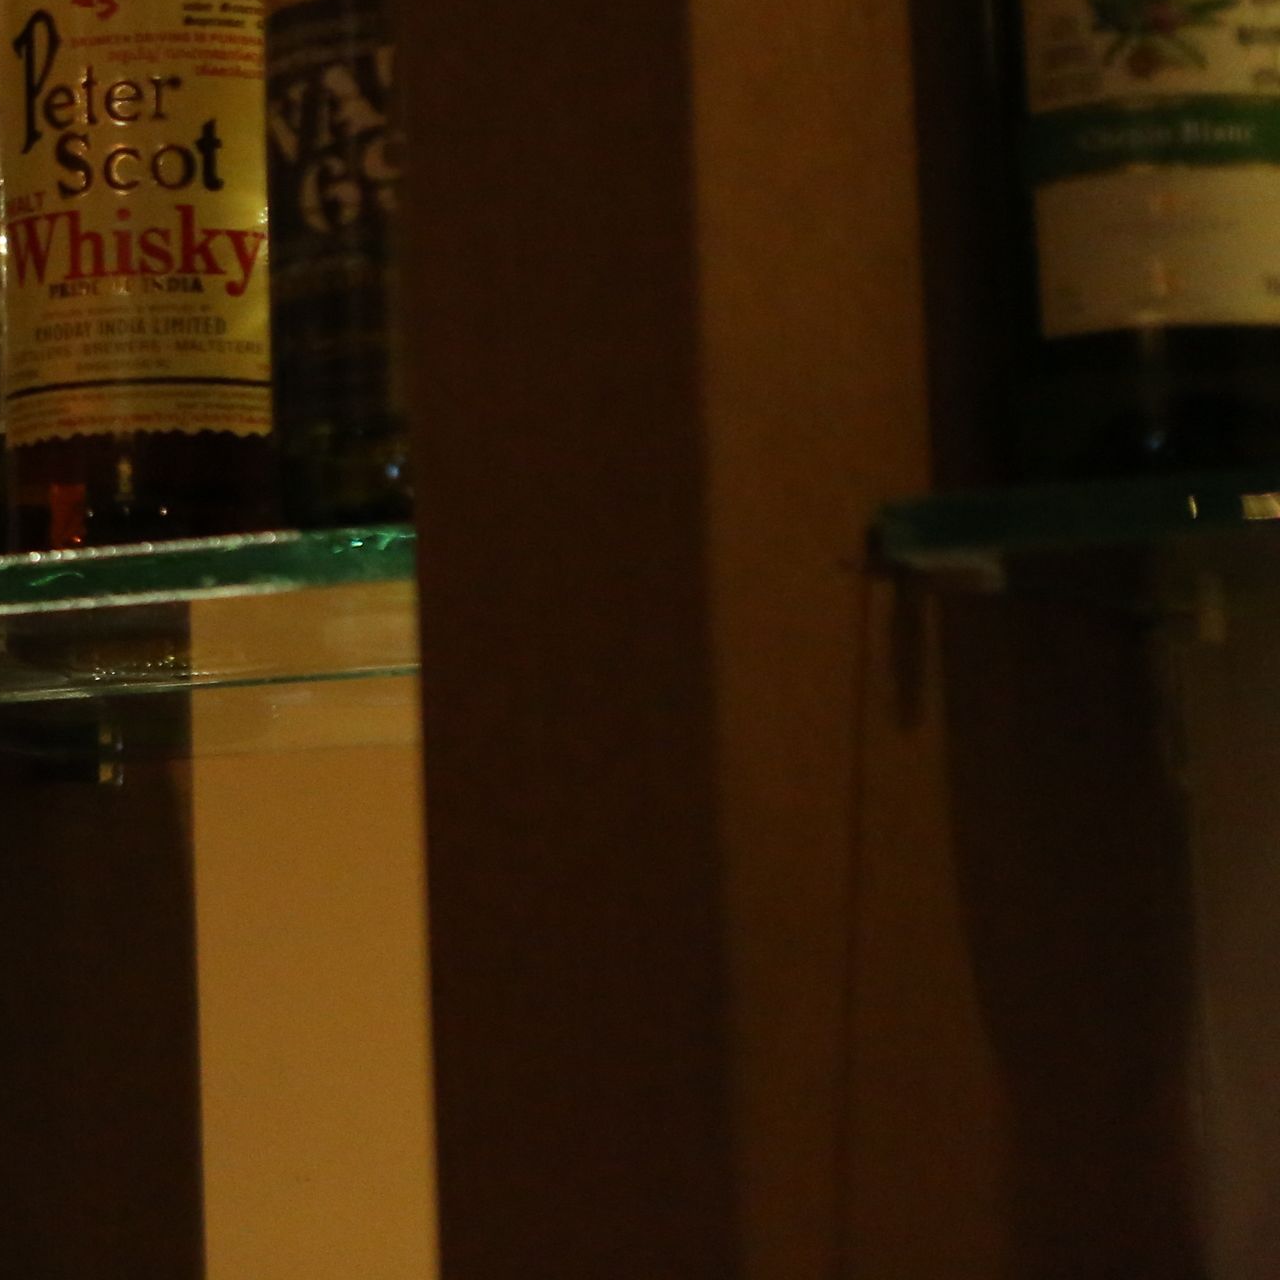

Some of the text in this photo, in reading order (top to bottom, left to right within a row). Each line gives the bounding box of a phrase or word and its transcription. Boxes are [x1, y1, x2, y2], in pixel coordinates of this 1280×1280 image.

[14, 9, 182, 155] Peter
[56, 121, 225, 199] Scot
[6, 204, 268, 297] Whisky
